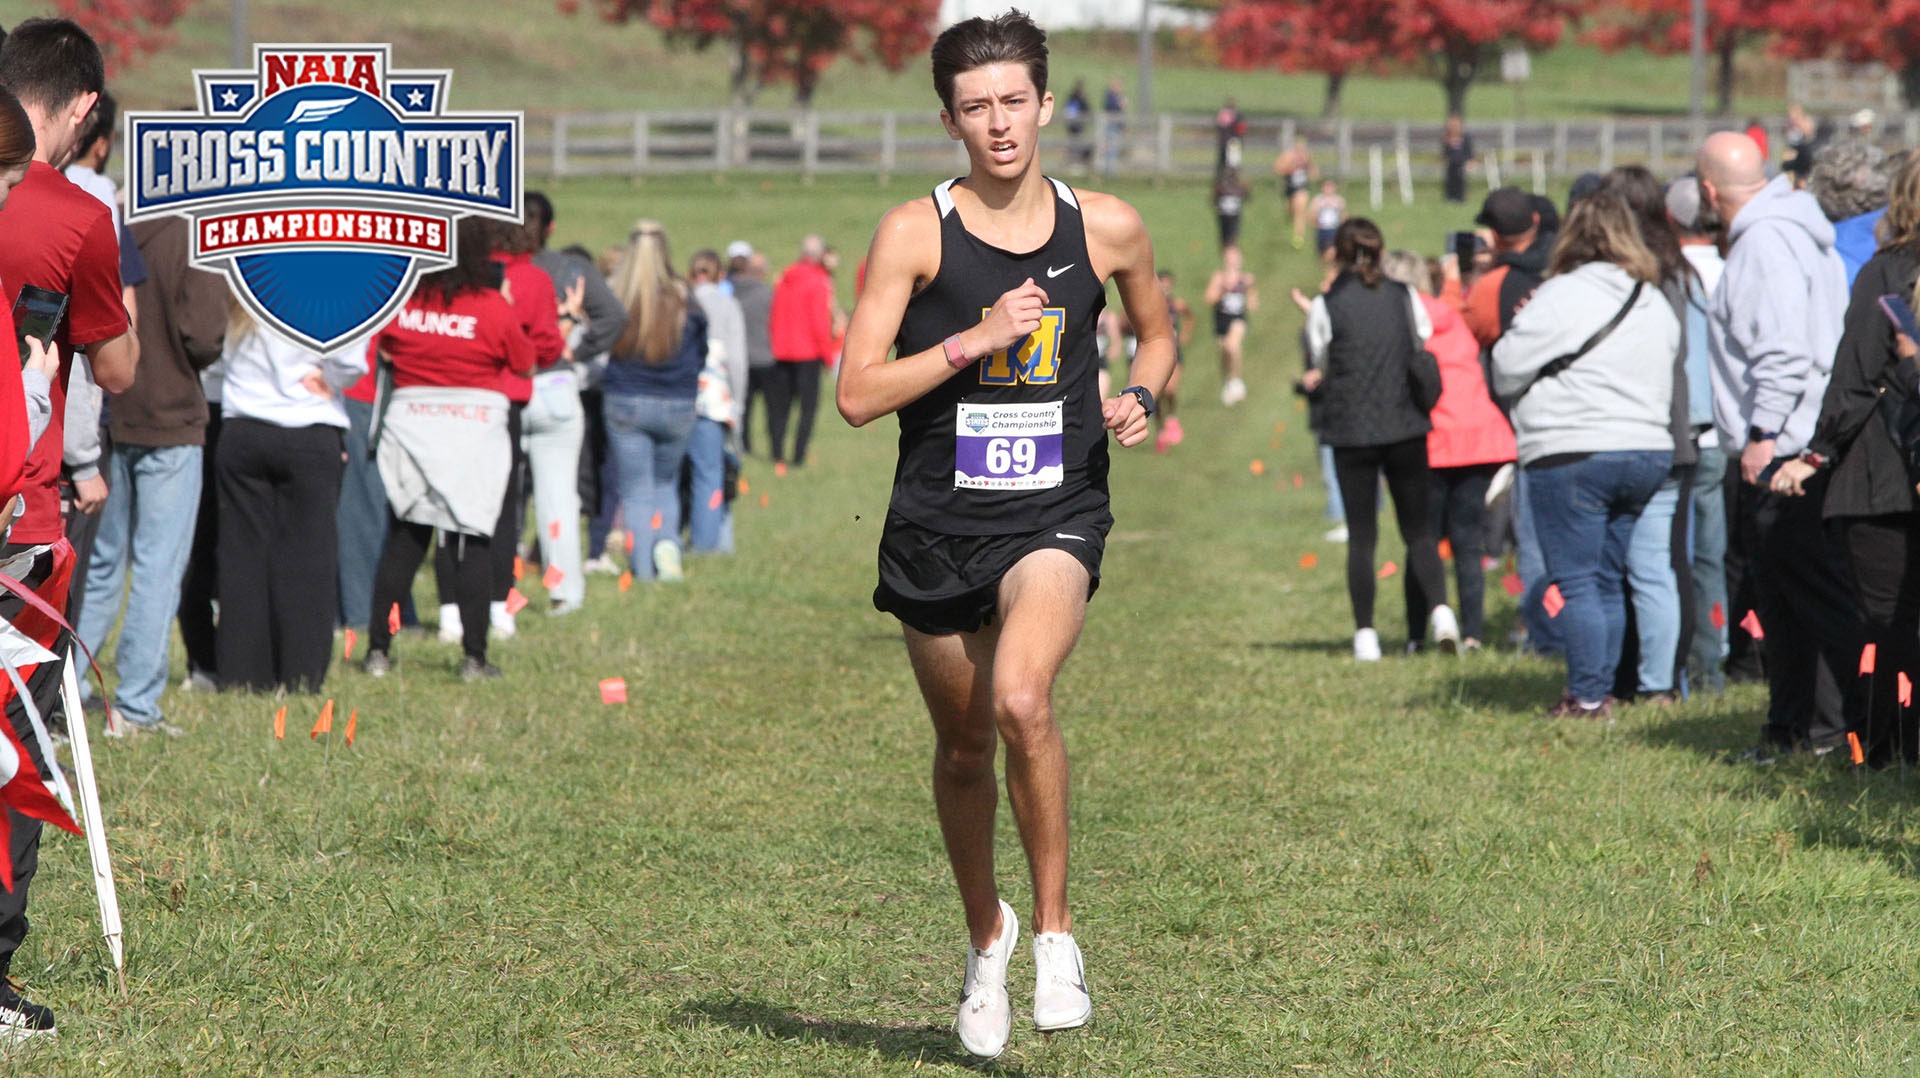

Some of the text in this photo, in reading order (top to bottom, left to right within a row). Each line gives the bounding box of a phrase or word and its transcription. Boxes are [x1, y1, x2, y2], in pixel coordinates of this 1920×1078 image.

[398, 308, 478, 339] MUNCIE
[992, 411, 1018, 419] Cross
[1021, 410, 1056, 418] Country
[991, 420, 1057, 430] Championship
[986, 437, 1036, 475] 69
